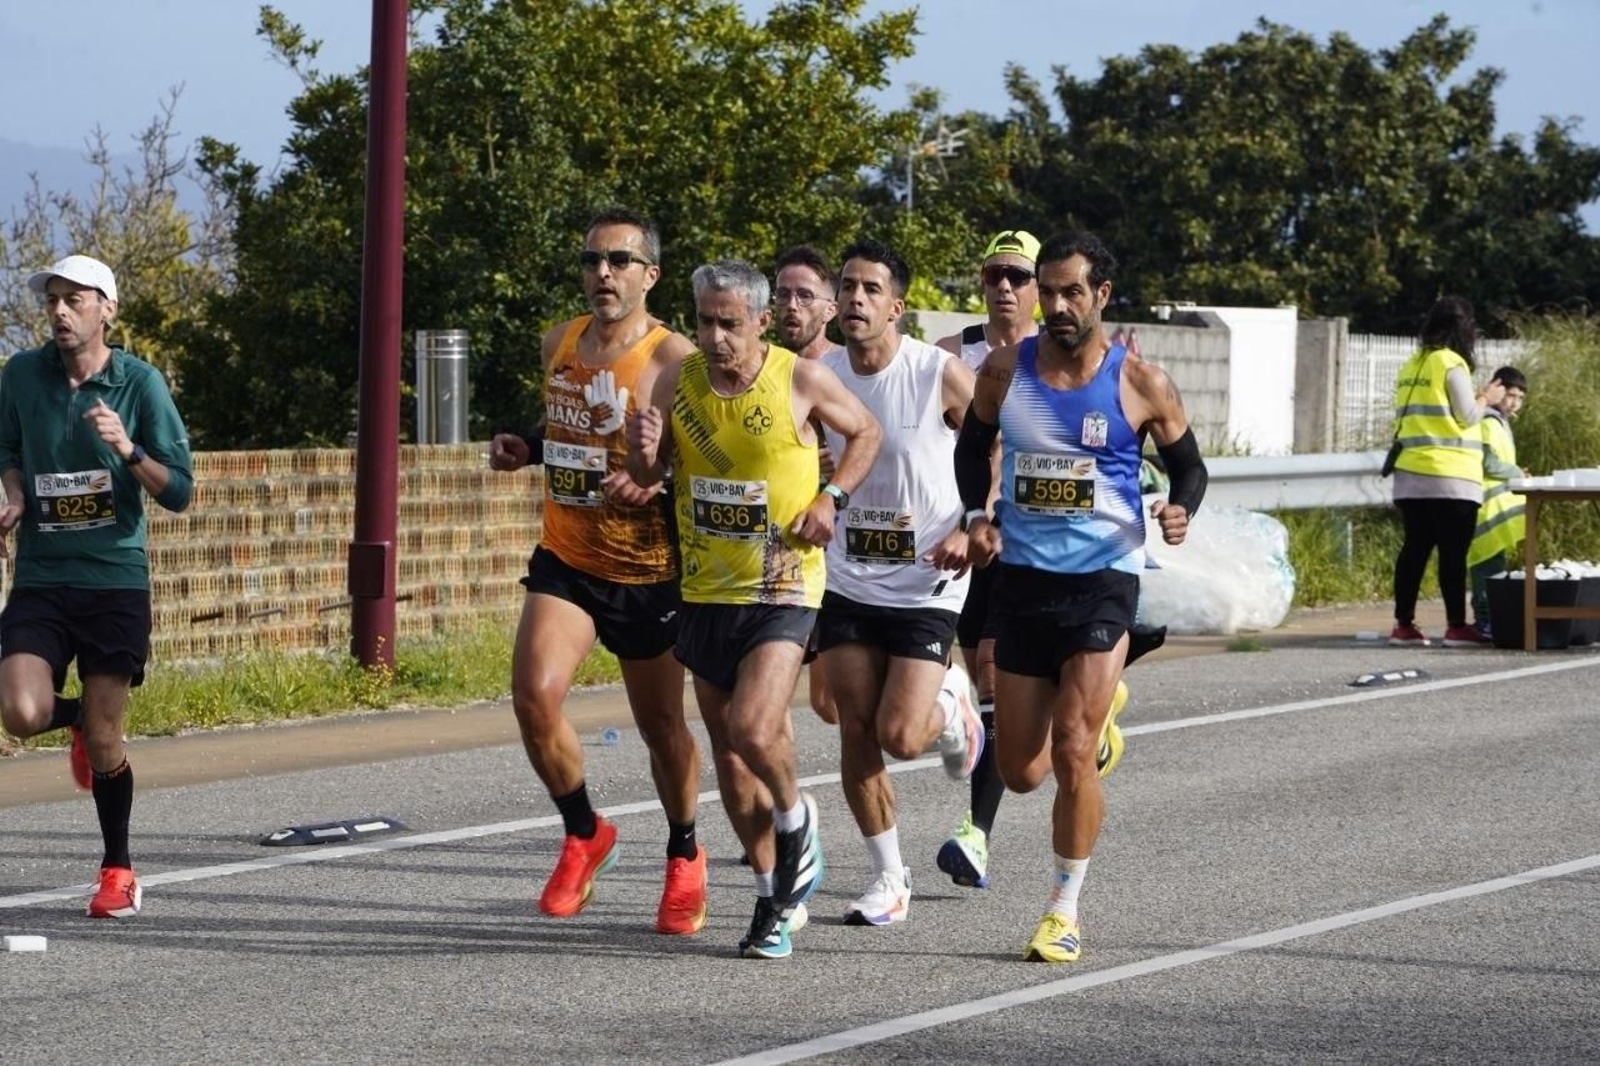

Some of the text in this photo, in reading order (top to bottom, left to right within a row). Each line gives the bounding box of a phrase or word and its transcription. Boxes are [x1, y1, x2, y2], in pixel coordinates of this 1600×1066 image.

[743, 416, 771, 428] C C
[753, 406, 763, 417] A
[554, 468, 586, 491] 591
[1034, 480, 1077, 501] 596
[57, 495, 97, 517] 625
[710, 504, 750, 527] 636
[862, 531, 898, 551] 716
